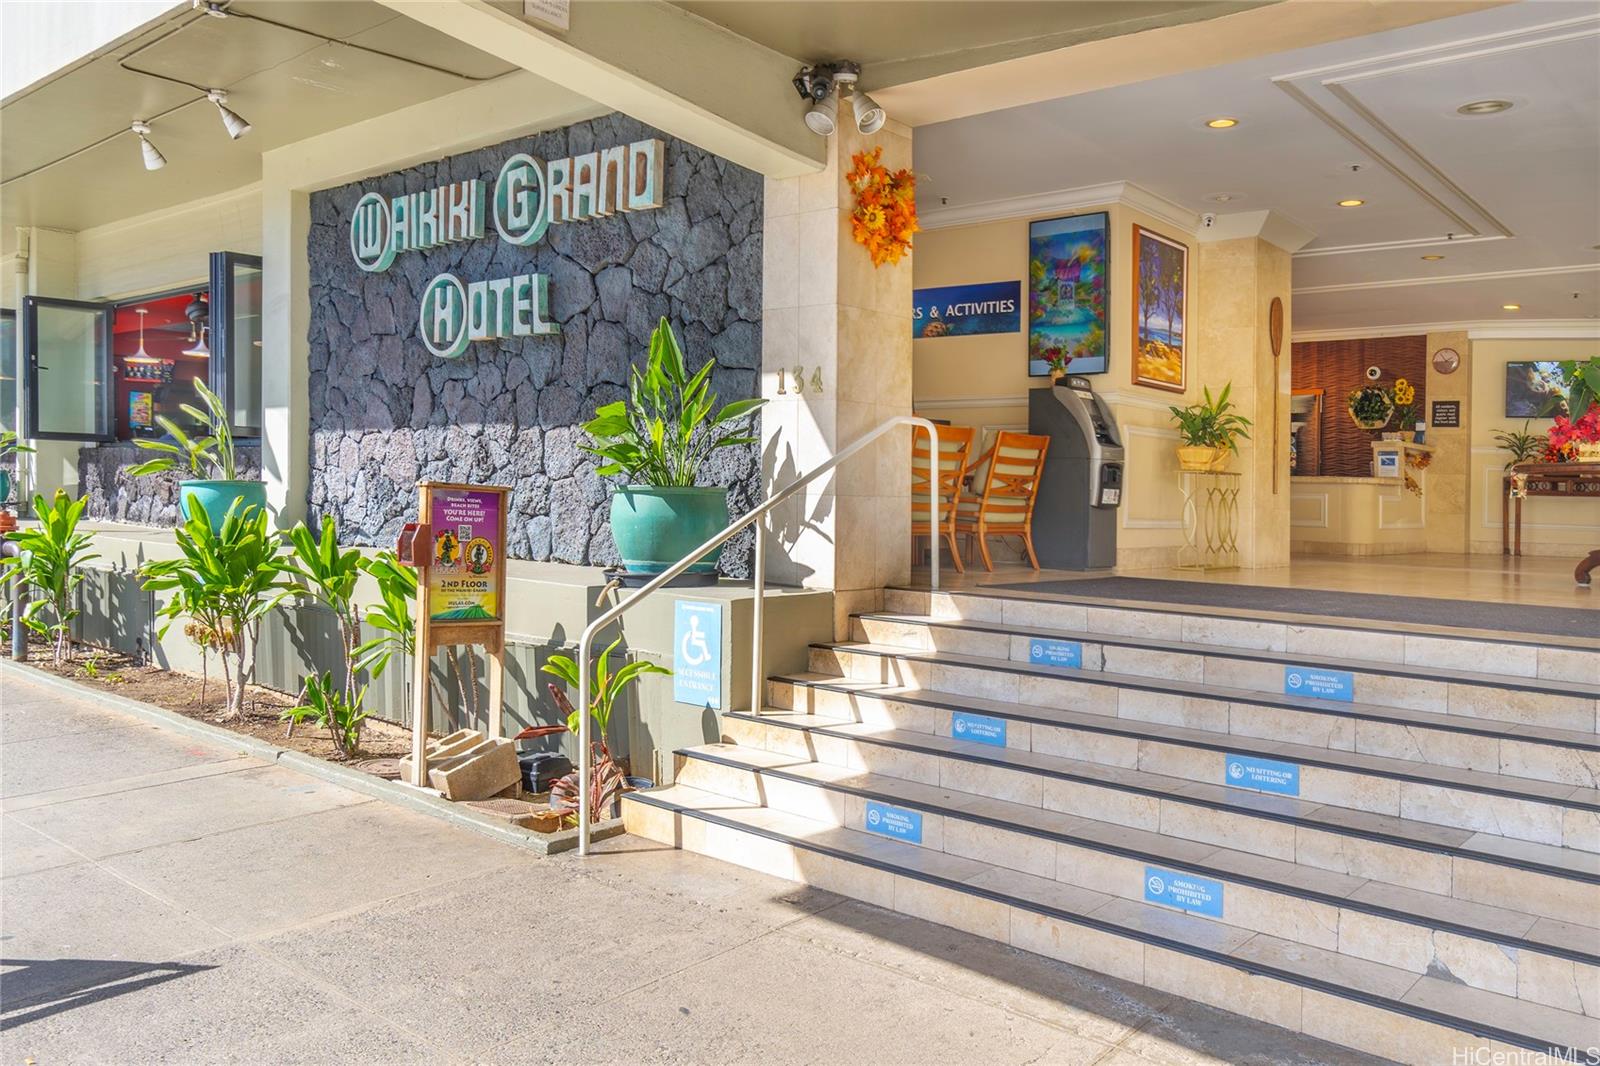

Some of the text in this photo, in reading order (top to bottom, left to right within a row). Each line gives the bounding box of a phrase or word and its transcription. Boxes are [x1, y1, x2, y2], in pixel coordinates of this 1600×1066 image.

[350, 138, 664, 272] WAIKIKI GRAND
[420, 273, 560, 358] HOTEL
[929, 305, 939, 318] &
[945, 299, 1015, 317] ACTIVITIES
[777, 366, 823, 395] 134
[441, 580, 488, 588] 2ND FLOOR
[1251, 773, 1287, 785] LOITERING
[1255, 767, 1281, 777] SITTING
[1168, 885, 1212, 901] PROHIBITED
[1173, 879, 1206, 893] SMOKING
[1176, 895, 1202, 906] BY LAW
